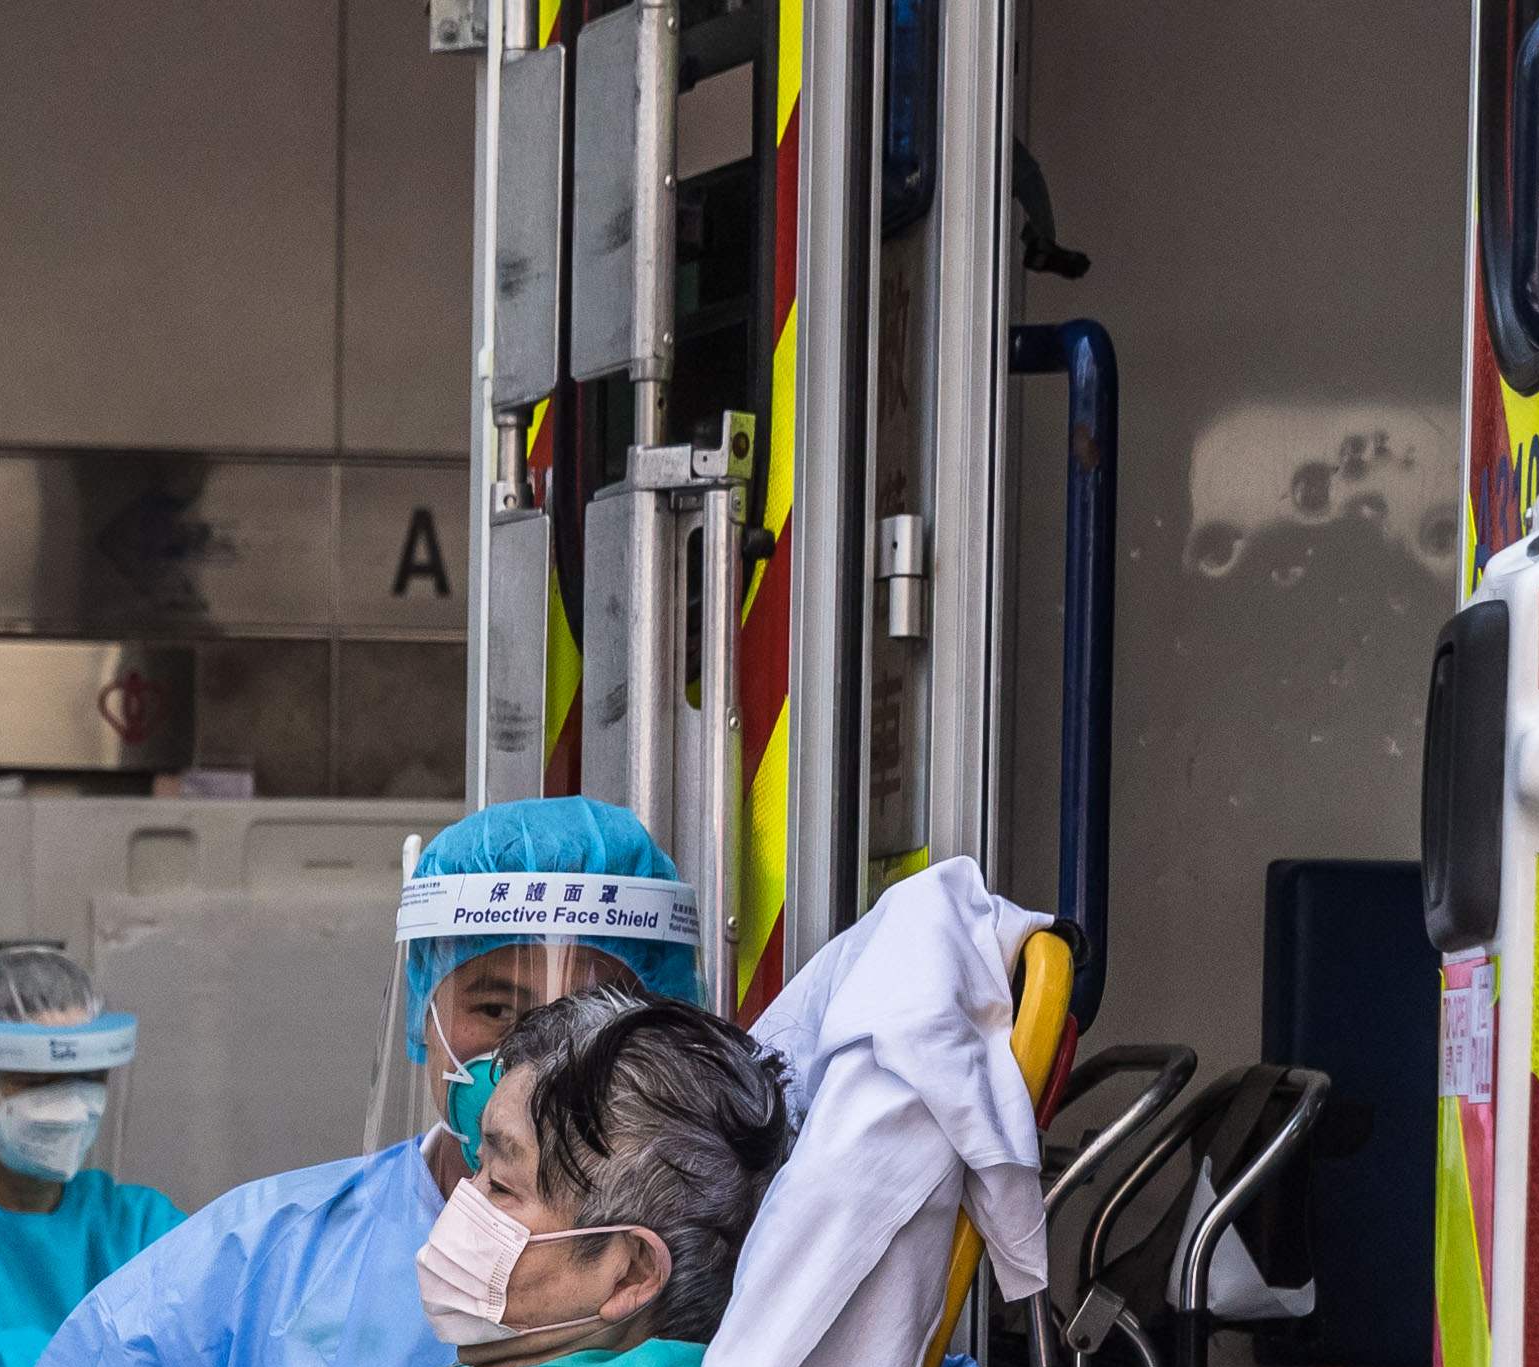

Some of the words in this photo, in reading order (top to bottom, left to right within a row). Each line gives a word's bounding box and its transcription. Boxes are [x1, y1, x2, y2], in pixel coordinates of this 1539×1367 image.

[391, 507, 452, 596] A
[490, 881, 619, 904] 保護面罩
[453, 906, 547, 926] Protective
[553, 906, 599, 924] Face
[605, 908, 659, 929] Shield
